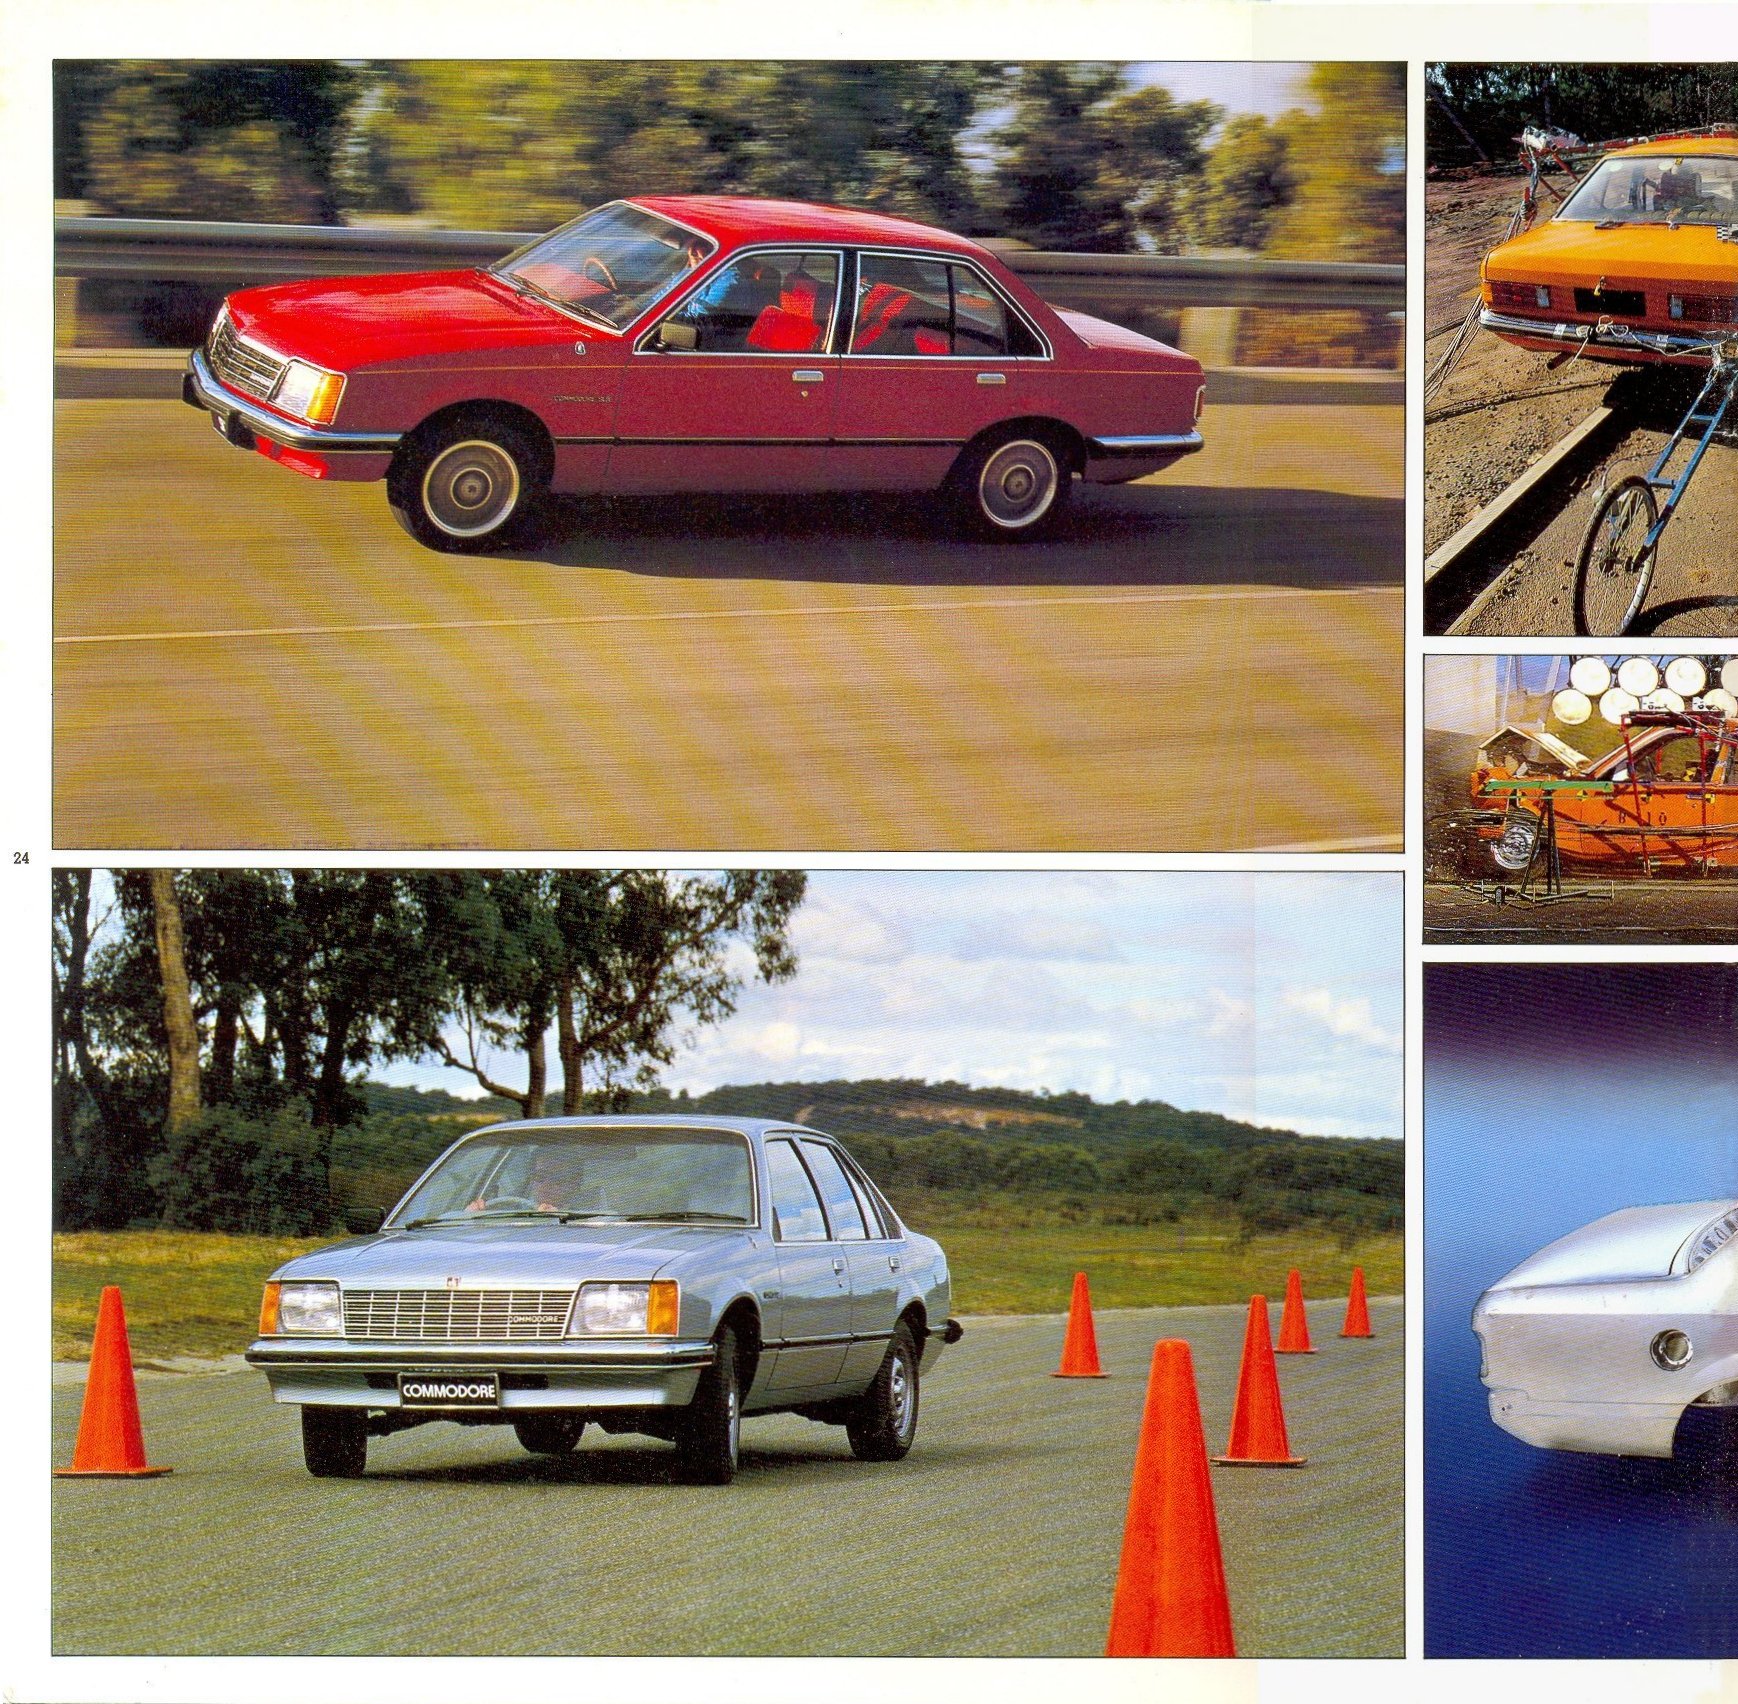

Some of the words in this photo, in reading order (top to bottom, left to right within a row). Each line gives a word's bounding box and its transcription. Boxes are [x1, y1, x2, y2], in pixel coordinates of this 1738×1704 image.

[13, 851, 30, 864] 24
[507, 1315, 560, 1323] COMMODORE
[403, 1383, 496, 1398] COMMODORE
